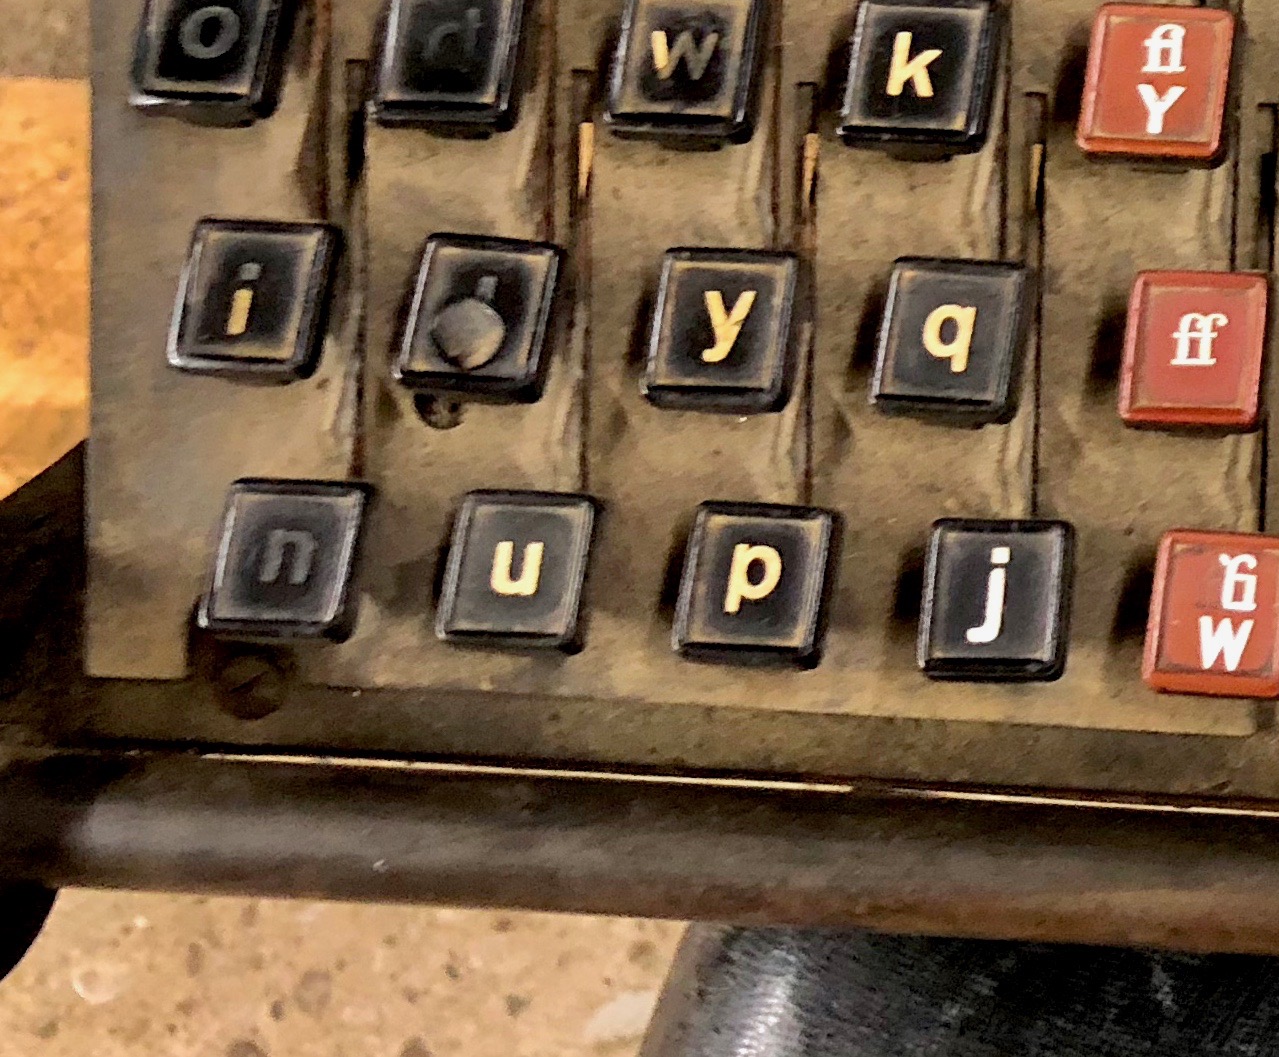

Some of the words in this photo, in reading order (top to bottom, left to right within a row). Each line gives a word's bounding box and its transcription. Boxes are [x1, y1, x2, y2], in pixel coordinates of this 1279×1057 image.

[886, 30, 943, 98] k
[1136, 82, 1188, 135] Y
[225, 261, 263, 336] i
[701, 290, 758, 364] y
[922, 303, 977, 374] q
[258, 528, 318, 586] n
[723, 542, 783, 616] p
[966, 546, 1012, 644] j
[1199, 614, 1256, 673] W
